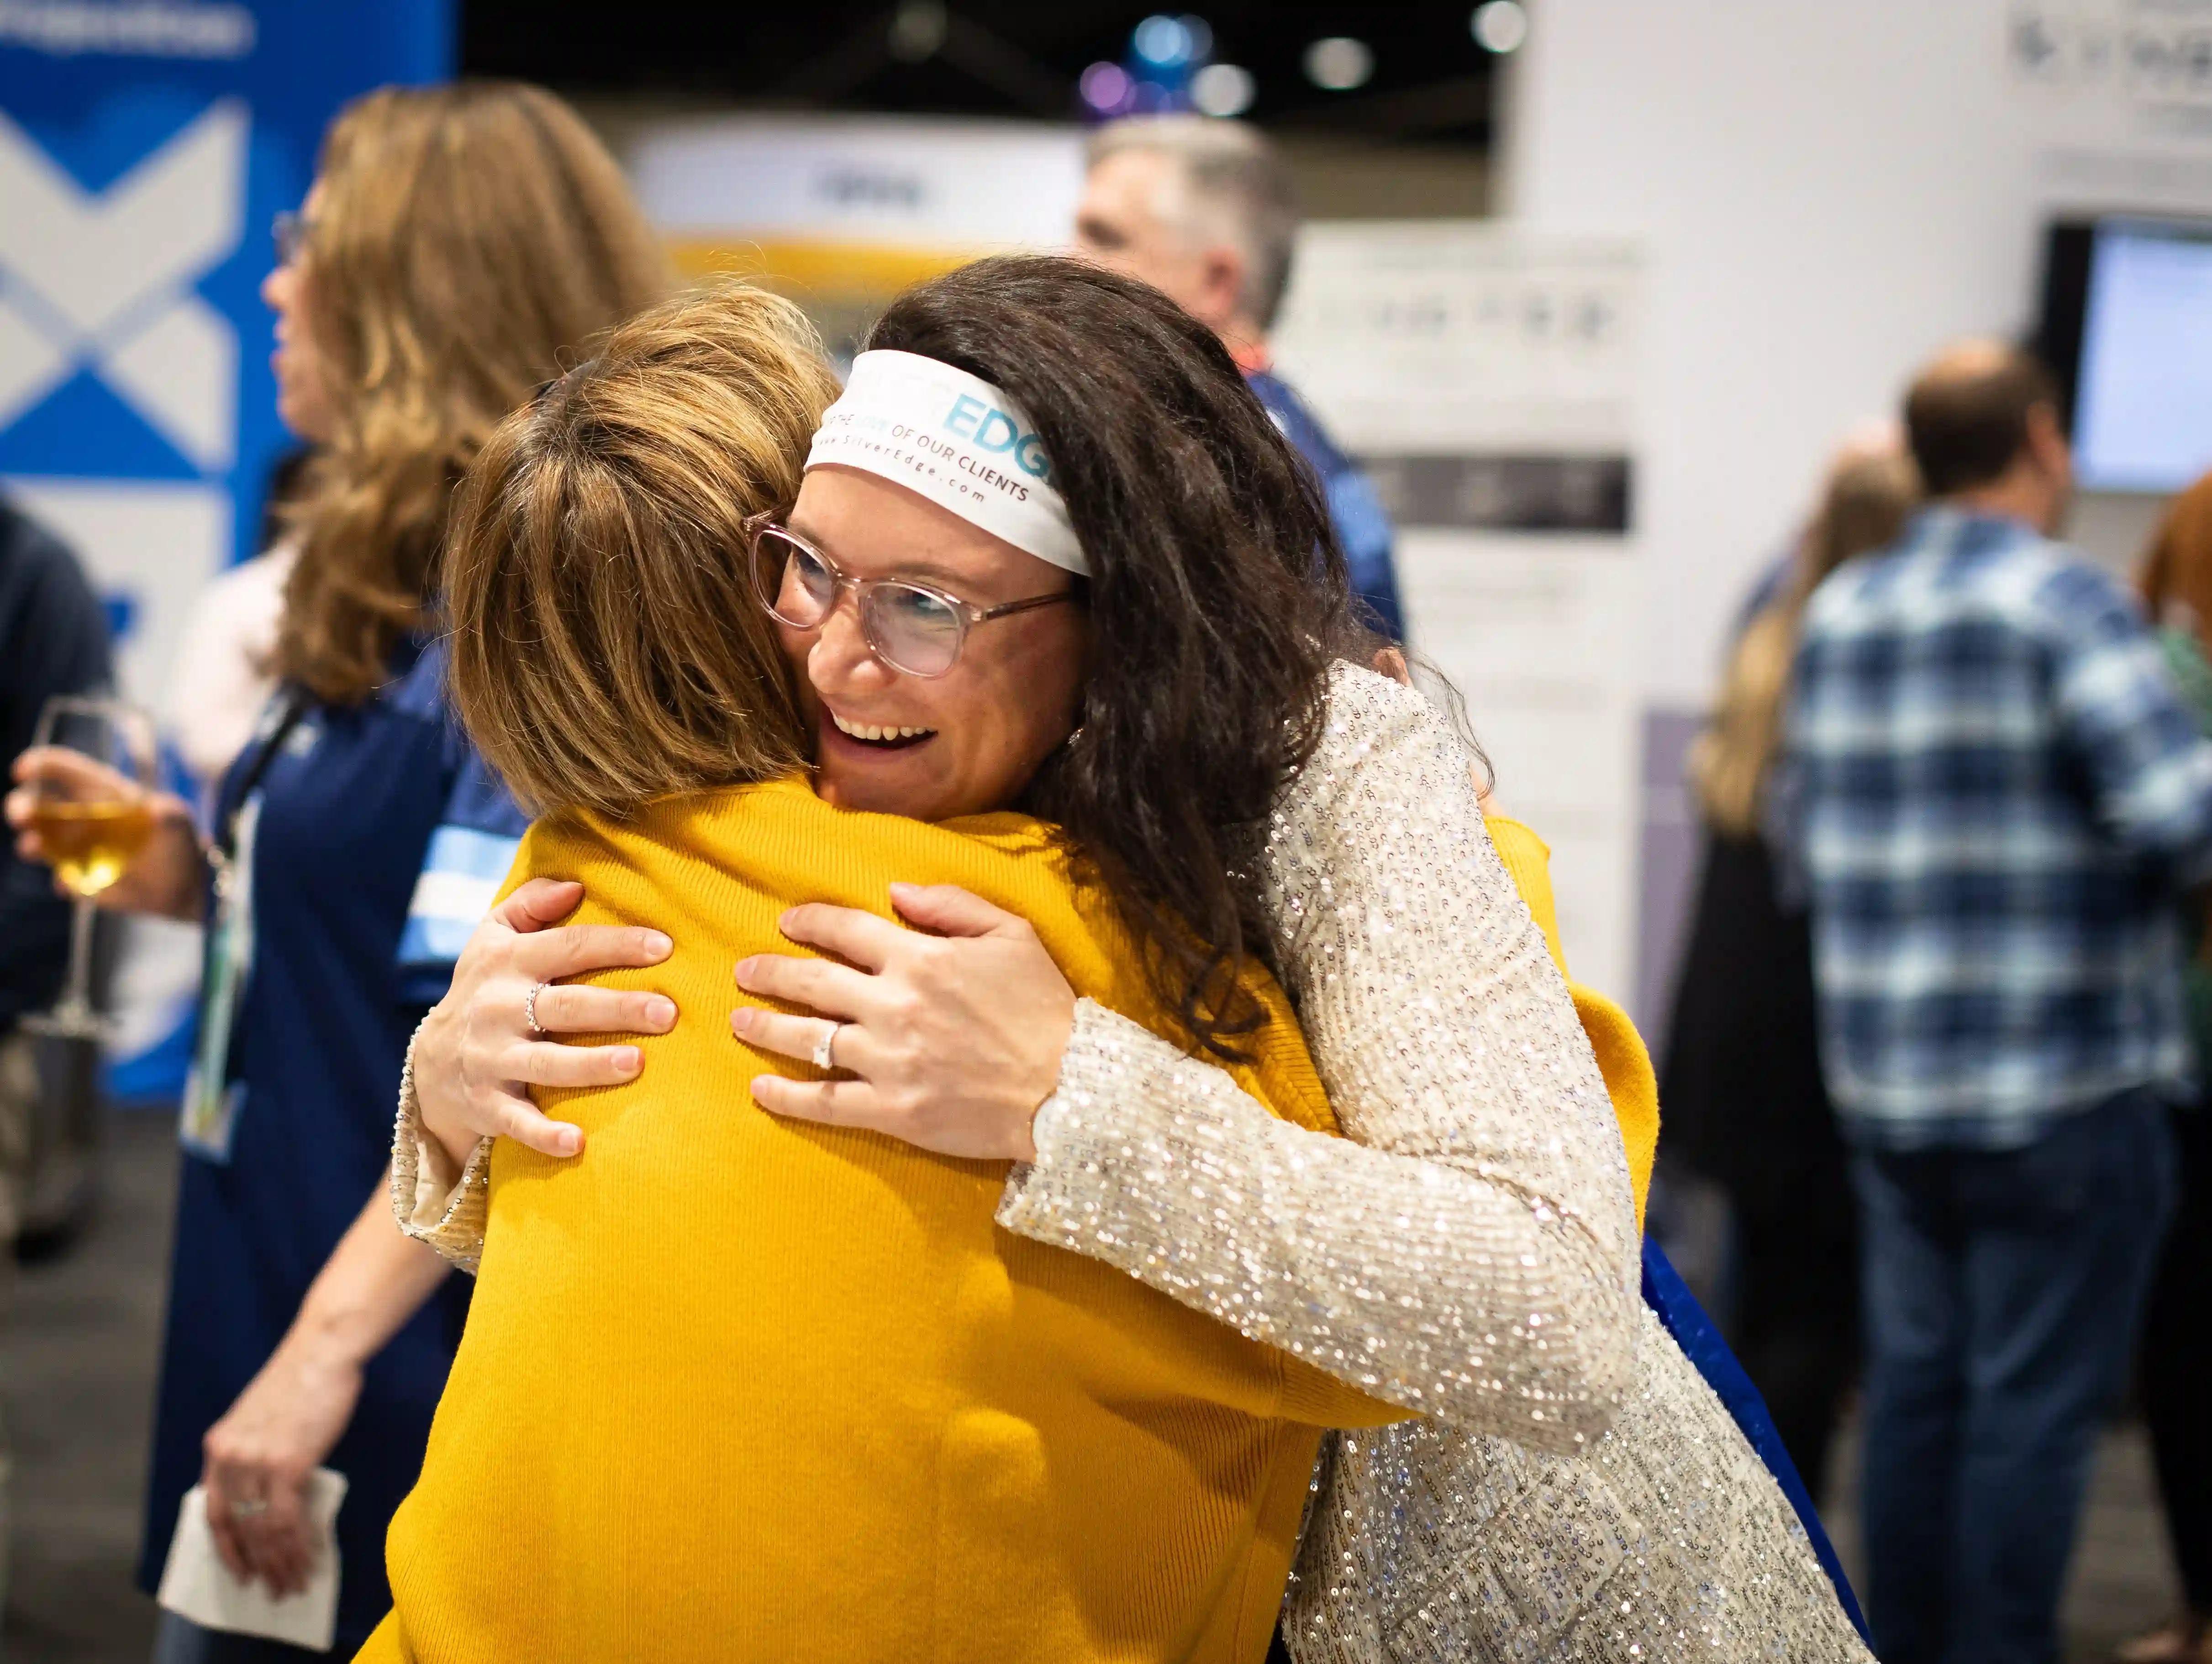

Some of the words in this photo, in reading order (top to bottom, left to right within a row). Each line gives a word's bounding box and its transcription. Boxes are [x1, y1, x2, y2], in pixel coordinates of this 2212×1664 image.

[892, 425, 915, 439] OF
[917, 436, 955, 461] OUR
[958, 456, 1029, 501] CLIENTS
[943, 393, 1049, 478] EDG
